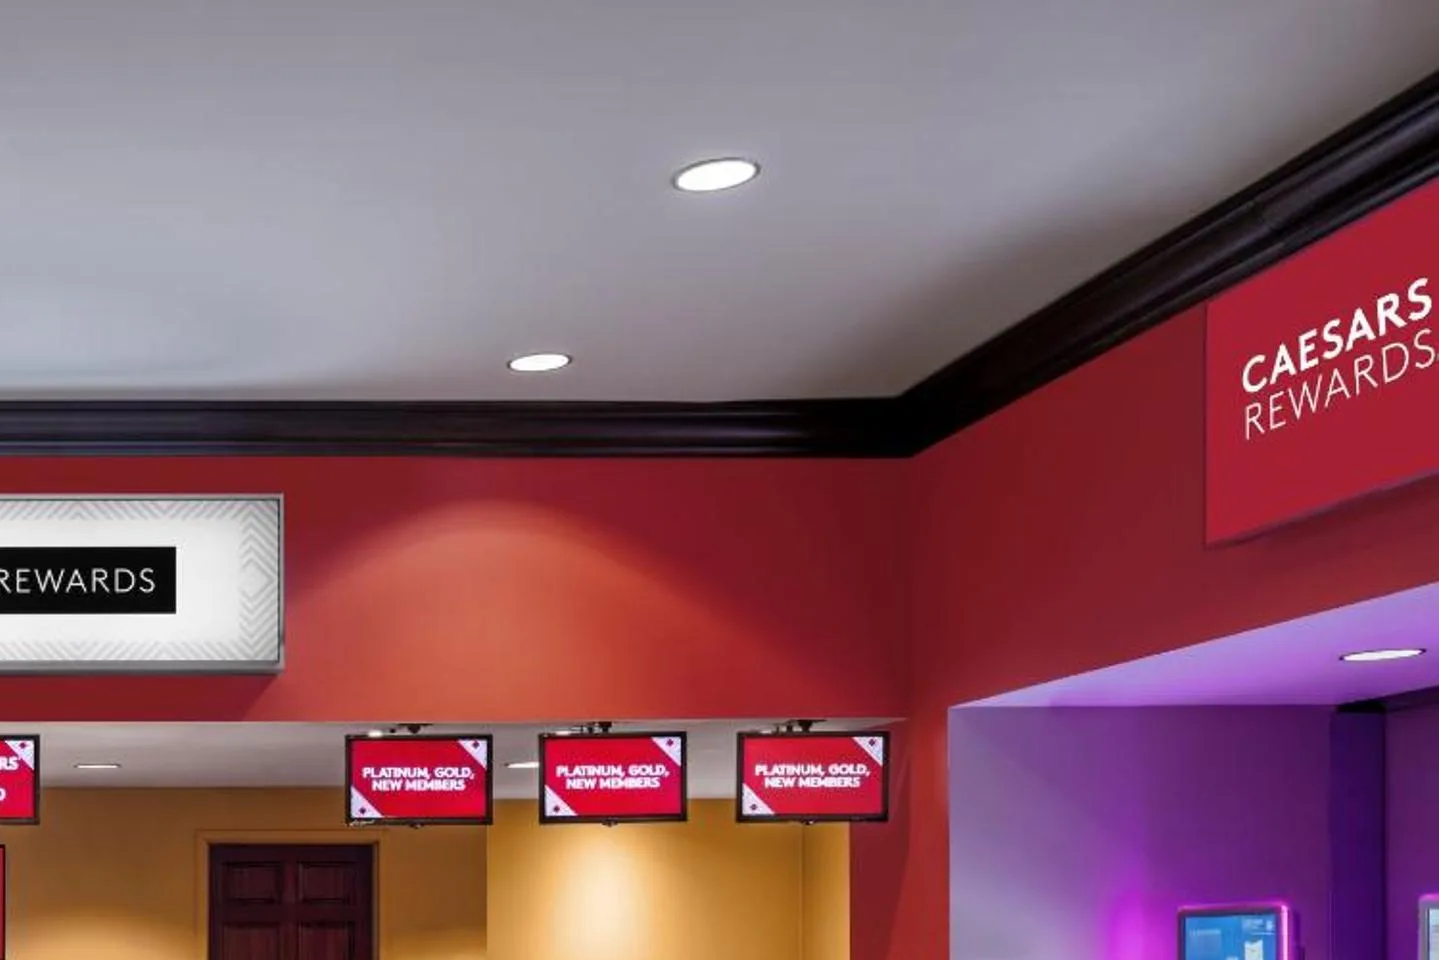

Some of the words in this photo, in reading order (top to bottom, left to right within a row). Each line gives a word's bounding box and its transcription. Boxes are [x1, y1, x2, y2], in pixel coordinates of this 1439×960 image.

[1242, 277, 1433, 393] CAESARS
[1245, 328, 1437, 440] REWARDS
[362, 766, 431, 780] PLATINUM,
[434, 766, 475, 780] GOLD,
[555, 764, 625, 778] PLATINUM,
[628, 764, 670, 777] GOLD,
[754, 763, 825, 777] PLATINUM,
[827, 763, 870, 777] GOLD,
[371, 779, 403, 791] NEW
[405, 779, 466, 791] MEMBERS
[566, 777, 597, 789] NEW
[599, 776, 660, 789] MEMBERS
[764, 776, 796, 788] NEW
[798, 776, 860, 788] MEMBERS
